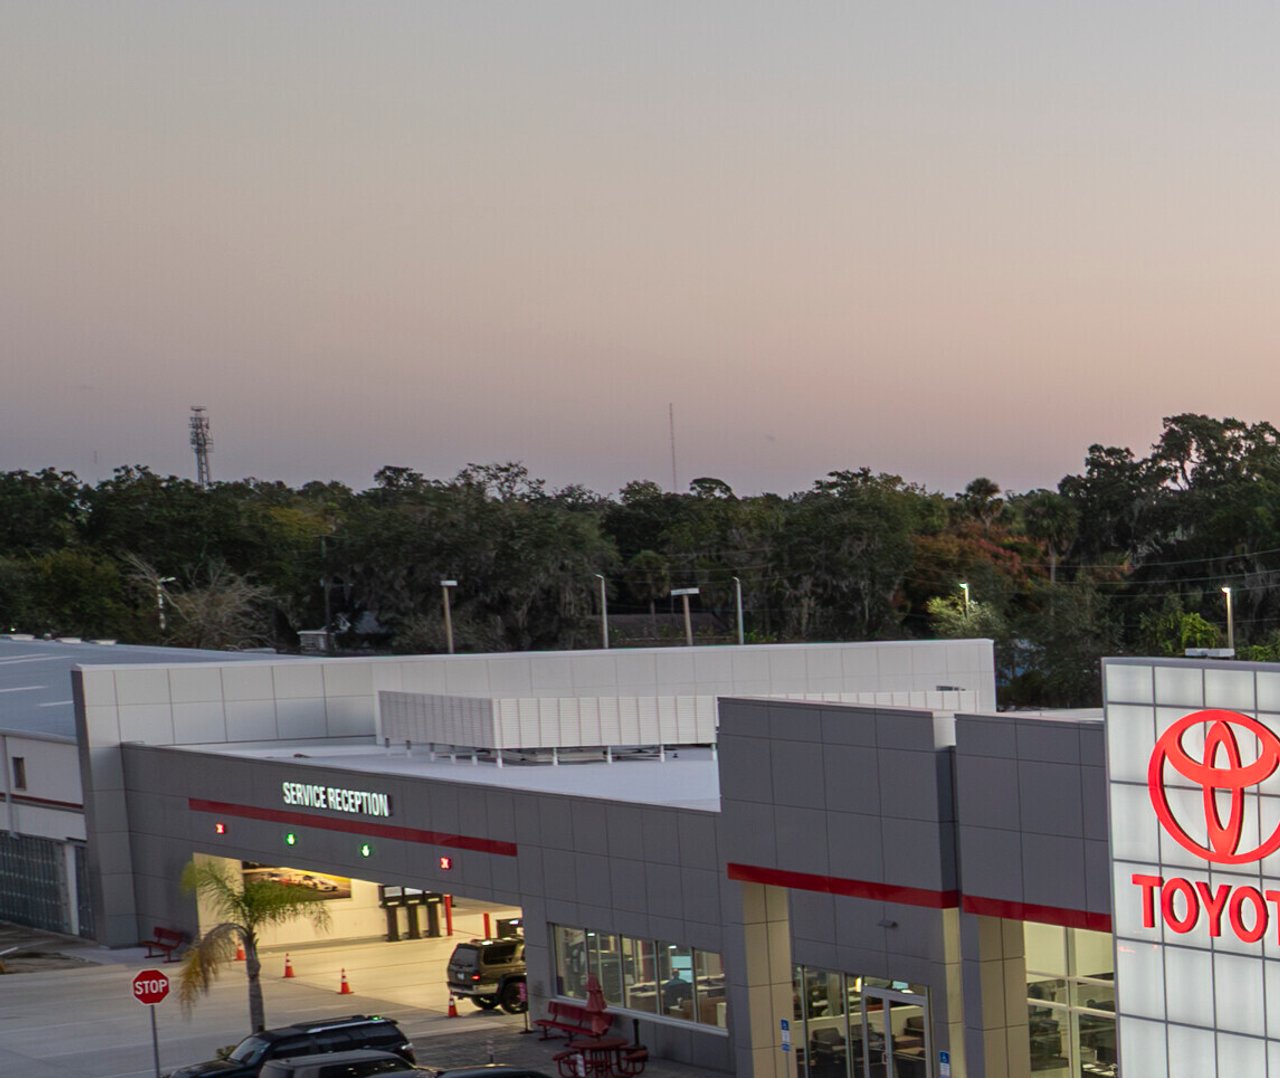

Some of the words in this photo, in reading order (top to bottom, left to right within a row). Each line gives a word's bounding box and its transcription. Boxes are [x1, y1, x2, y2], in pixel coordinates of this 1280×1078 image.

[283, 782, 327, 808] SERVICE
[327, 787, 389, 817] RECEPTION
[135, 979, 168, 995] STOP
